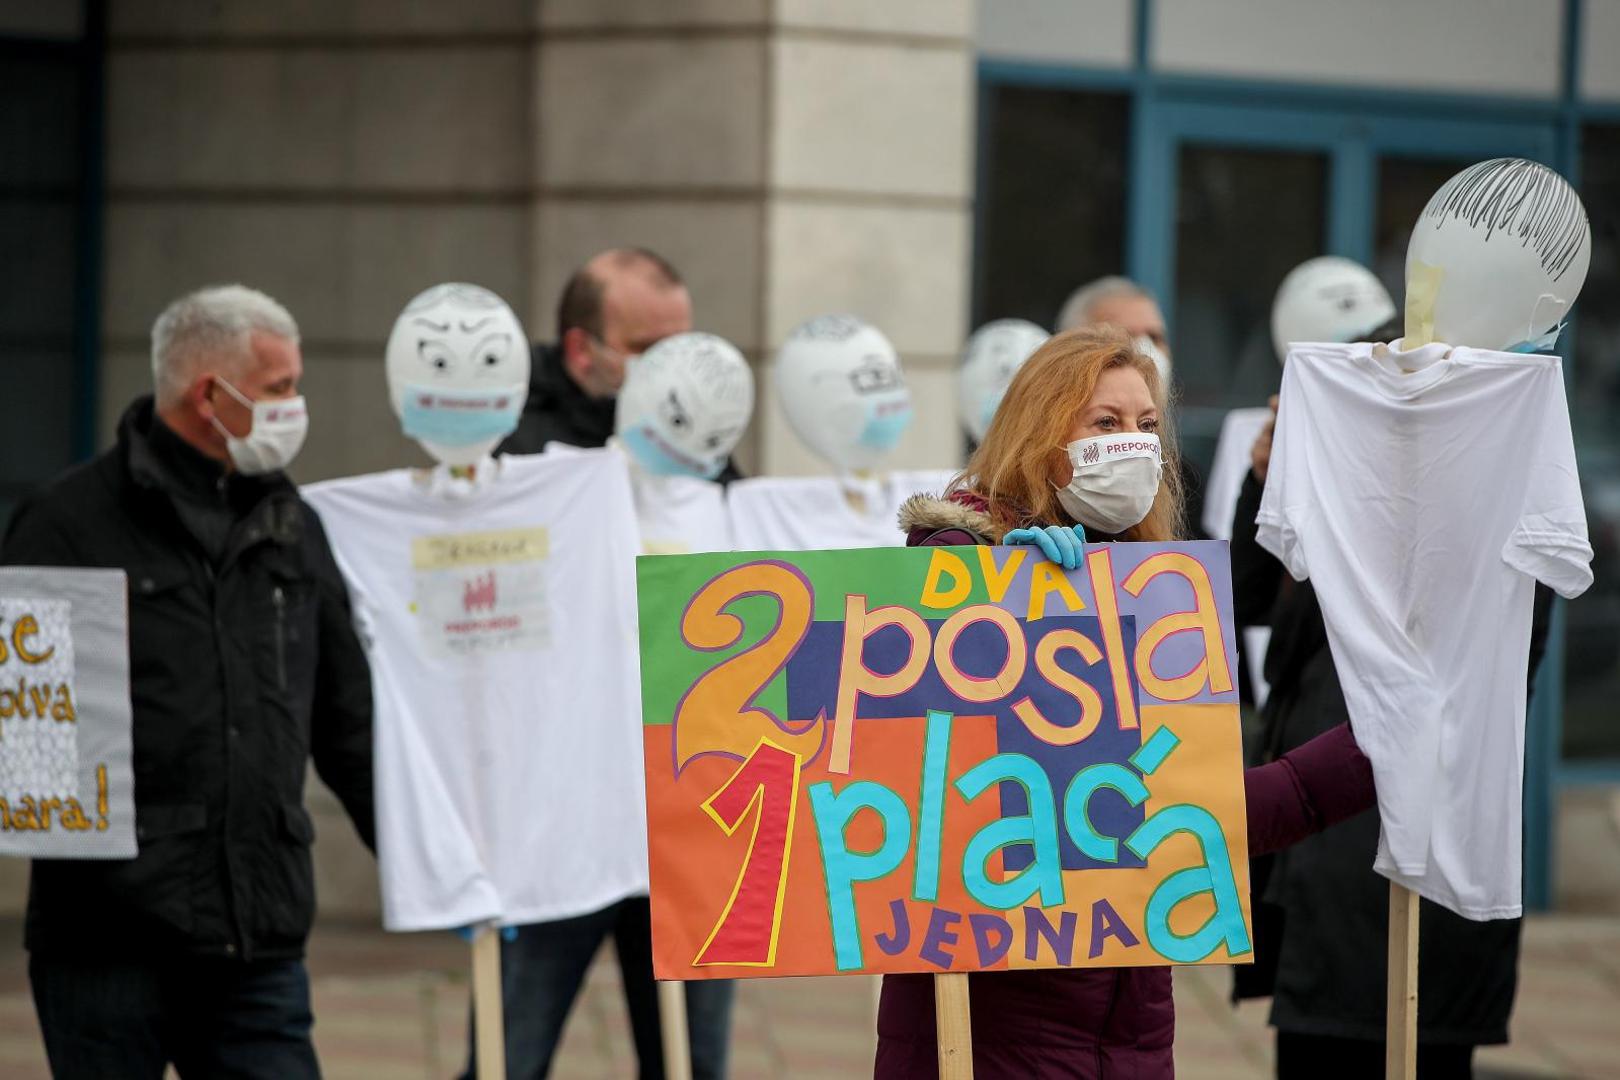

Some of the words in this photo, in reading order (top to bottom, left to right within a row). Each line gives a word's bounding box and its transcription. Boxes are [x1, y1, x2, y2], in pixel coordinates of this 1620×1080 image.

[920, 545, 1088, 622] DVA
[672, 559, 828, 780] 2
[827, 547, 1234, 776] posla
[691, 736, 802, 968] 1
[808, 709, 1252, 972] plaća
[874, 898, 1140, 970] JEDNA
